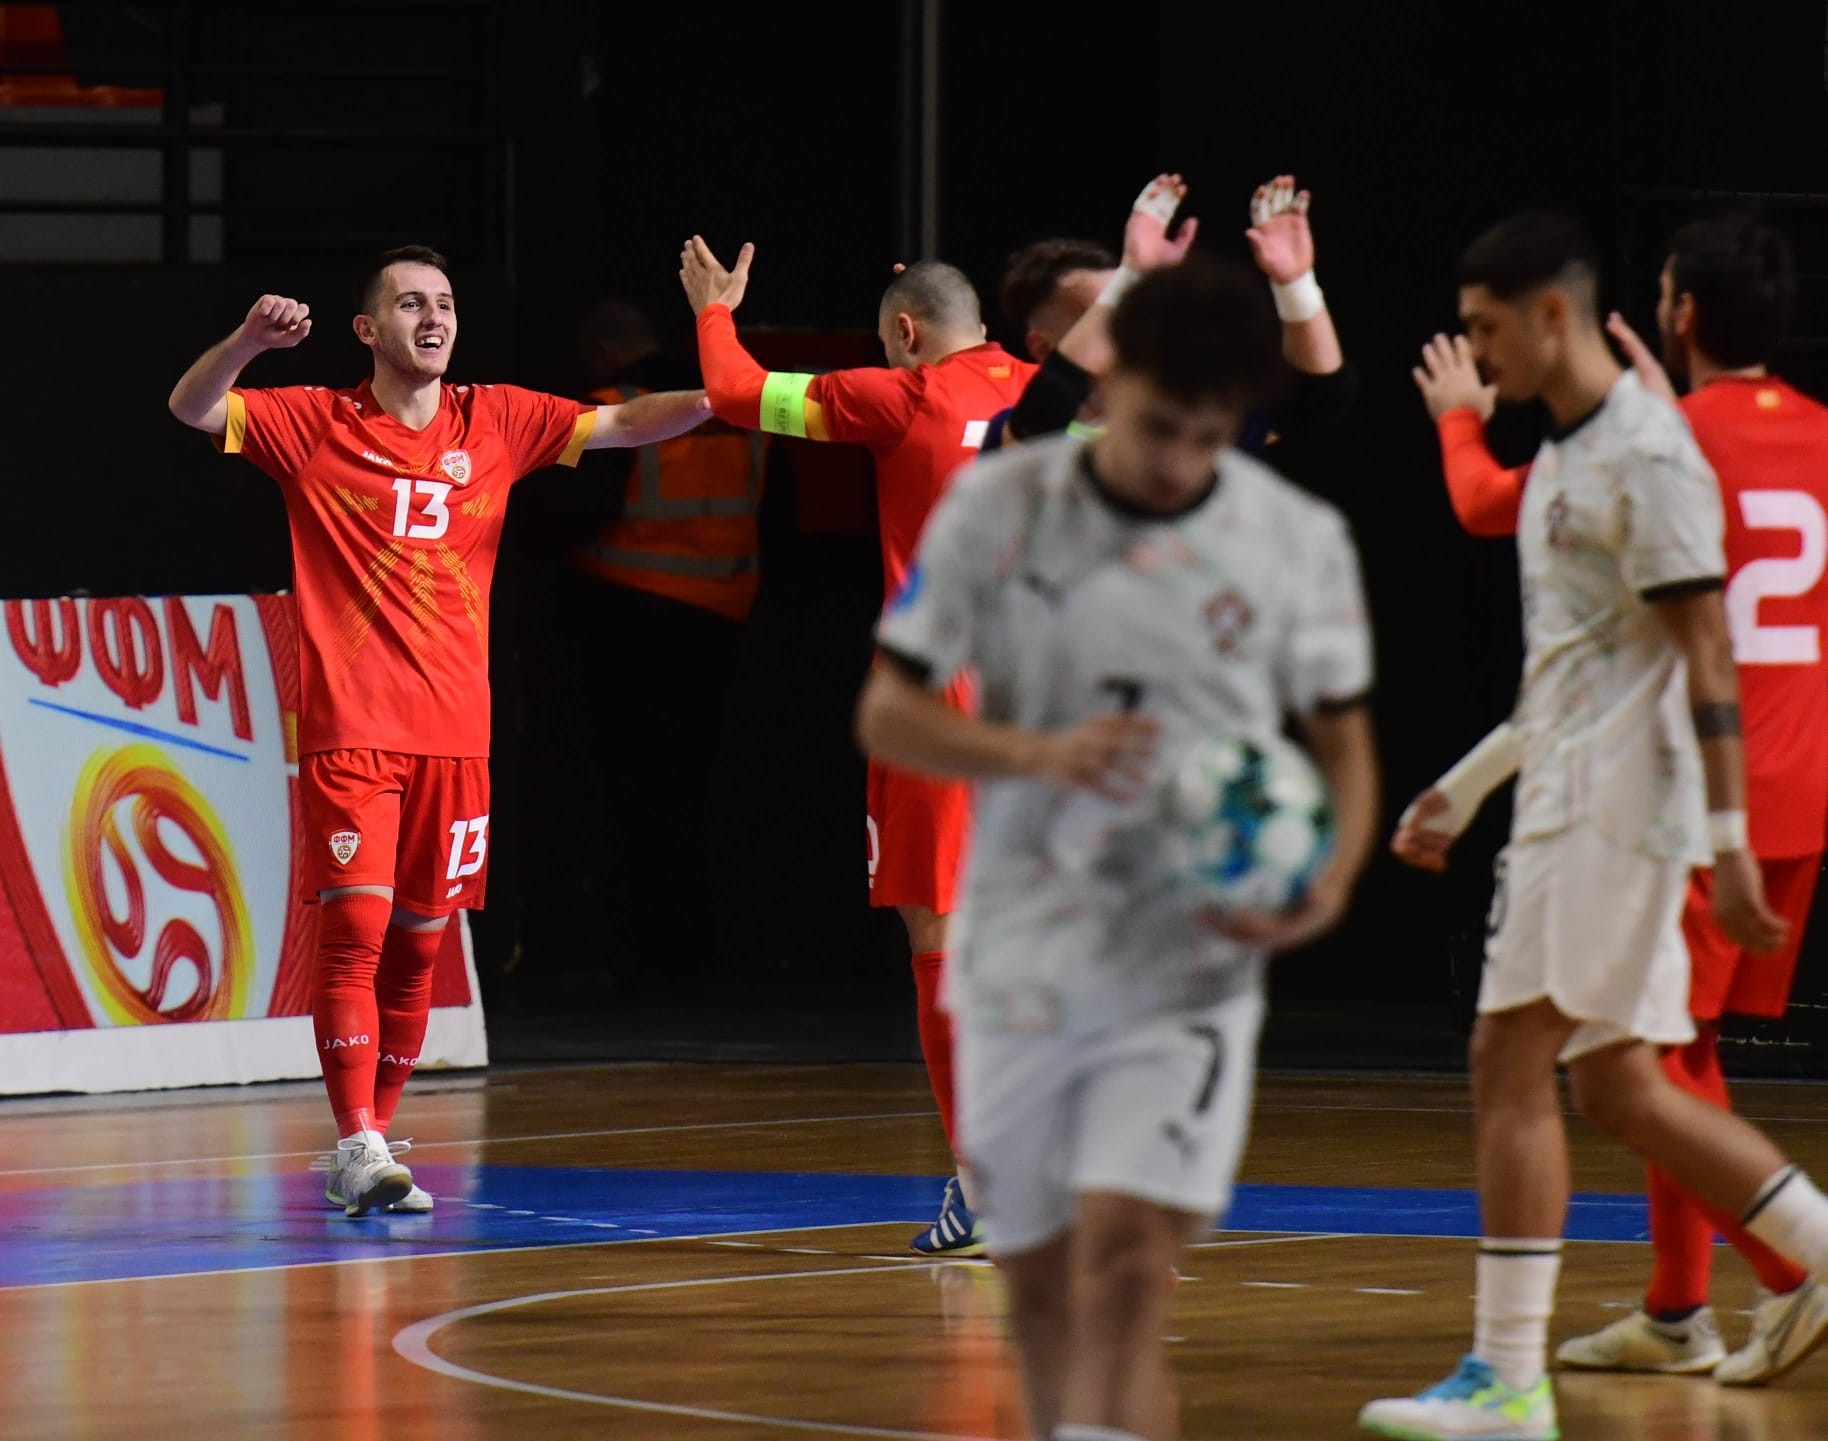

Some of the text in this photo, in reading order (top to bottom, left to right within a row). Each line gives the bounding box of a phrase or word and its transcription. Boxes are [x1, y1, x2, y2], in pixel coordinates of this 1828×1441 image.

[362, 451, 392, 466] JAKO
[391, 477, 454, 539] 13
[1724, 489, 1827, 664] 2
[446, 814, 489, 879] 13
[323, 1034, 369, 1050] JAKO
[1187, 1023, 1228, 1118] 7
